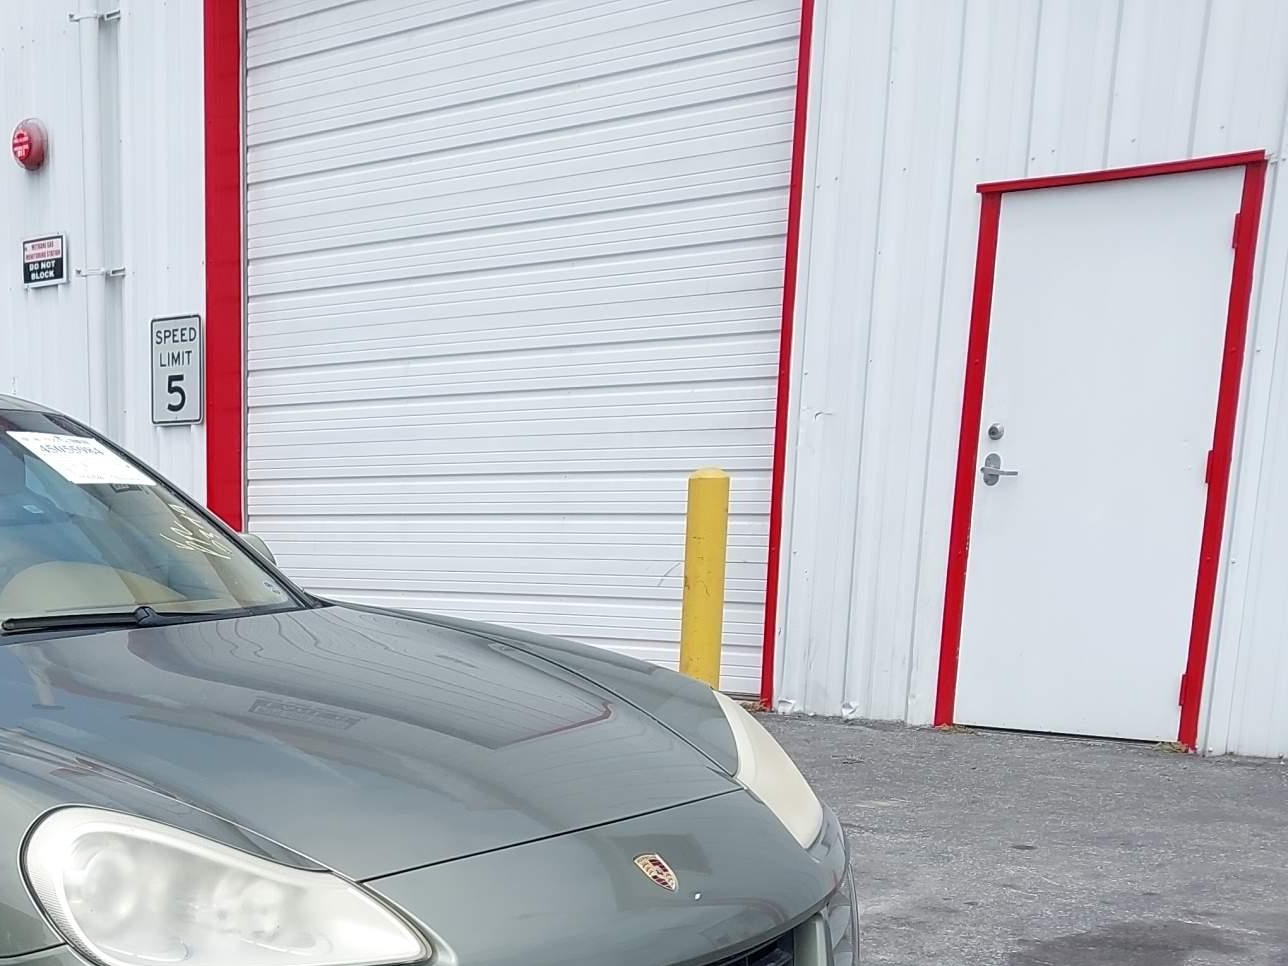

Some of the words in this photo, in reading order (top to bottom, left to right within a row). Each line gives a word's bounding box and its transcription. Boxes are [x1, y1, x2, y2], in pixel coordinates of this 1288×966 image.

[29, 263, 39, 271] DO
[41, 260, 55, 269] NOT
[31, 270, 55, 280] BLOCK
[155, 327, 197, 345] SPEED
[159, 350, 193, 367] LIMIT
[167, 374, 186, 412] 5
